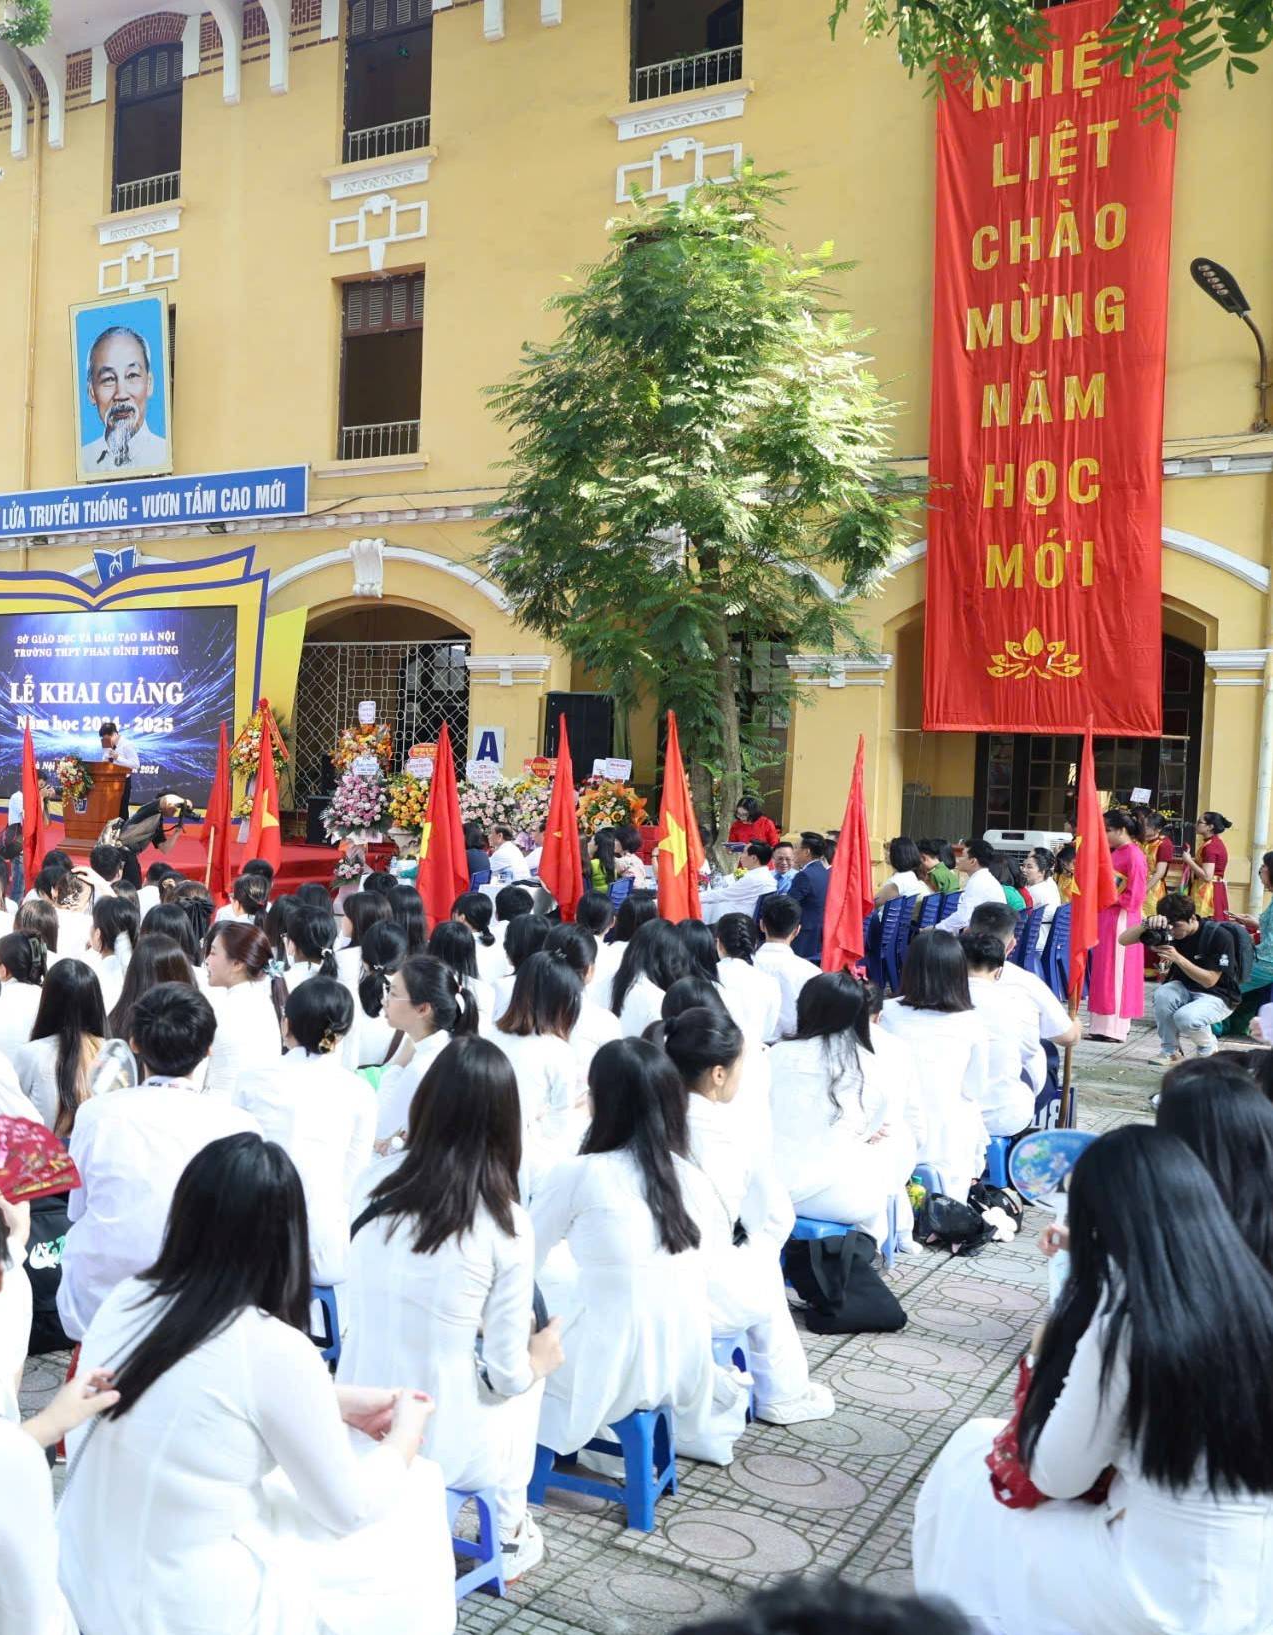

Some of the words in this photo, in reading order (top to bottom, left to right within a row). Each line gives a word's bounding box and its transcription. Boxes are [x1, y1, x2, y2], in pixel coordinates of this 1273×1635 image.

[973, 30, 1135, 112] NHIỆ
[992, 119, 1119, 187] LIỆT
[972, 198, 1127, 271] CHÀO
[966, 282, 1125, 351] MỪNG
[981, 369, 1105, 428] NĂM
[2, 500, 26, 530] LỬA
[83, 491, 128, 523] THỐNG
[141, 490, 180, 519] VƯƠN
[220, 486, 251, 513] CAO
[255, 478, 287, 510] MỚI
[982, 457, 1100, 515] HỌC
[985, 528, 1093, 589] MỚI
[55, 647, 80, 657] THPT
[83, 647, 112, 656] PHAN
[9, 674, 35, 704] LỄ
[39, 682, 101, 704] KHAI
[105, 677, 185, 705] GIẢNG
[133, 716, 174, 733] 2025
[476, 731, 500, 763] A
